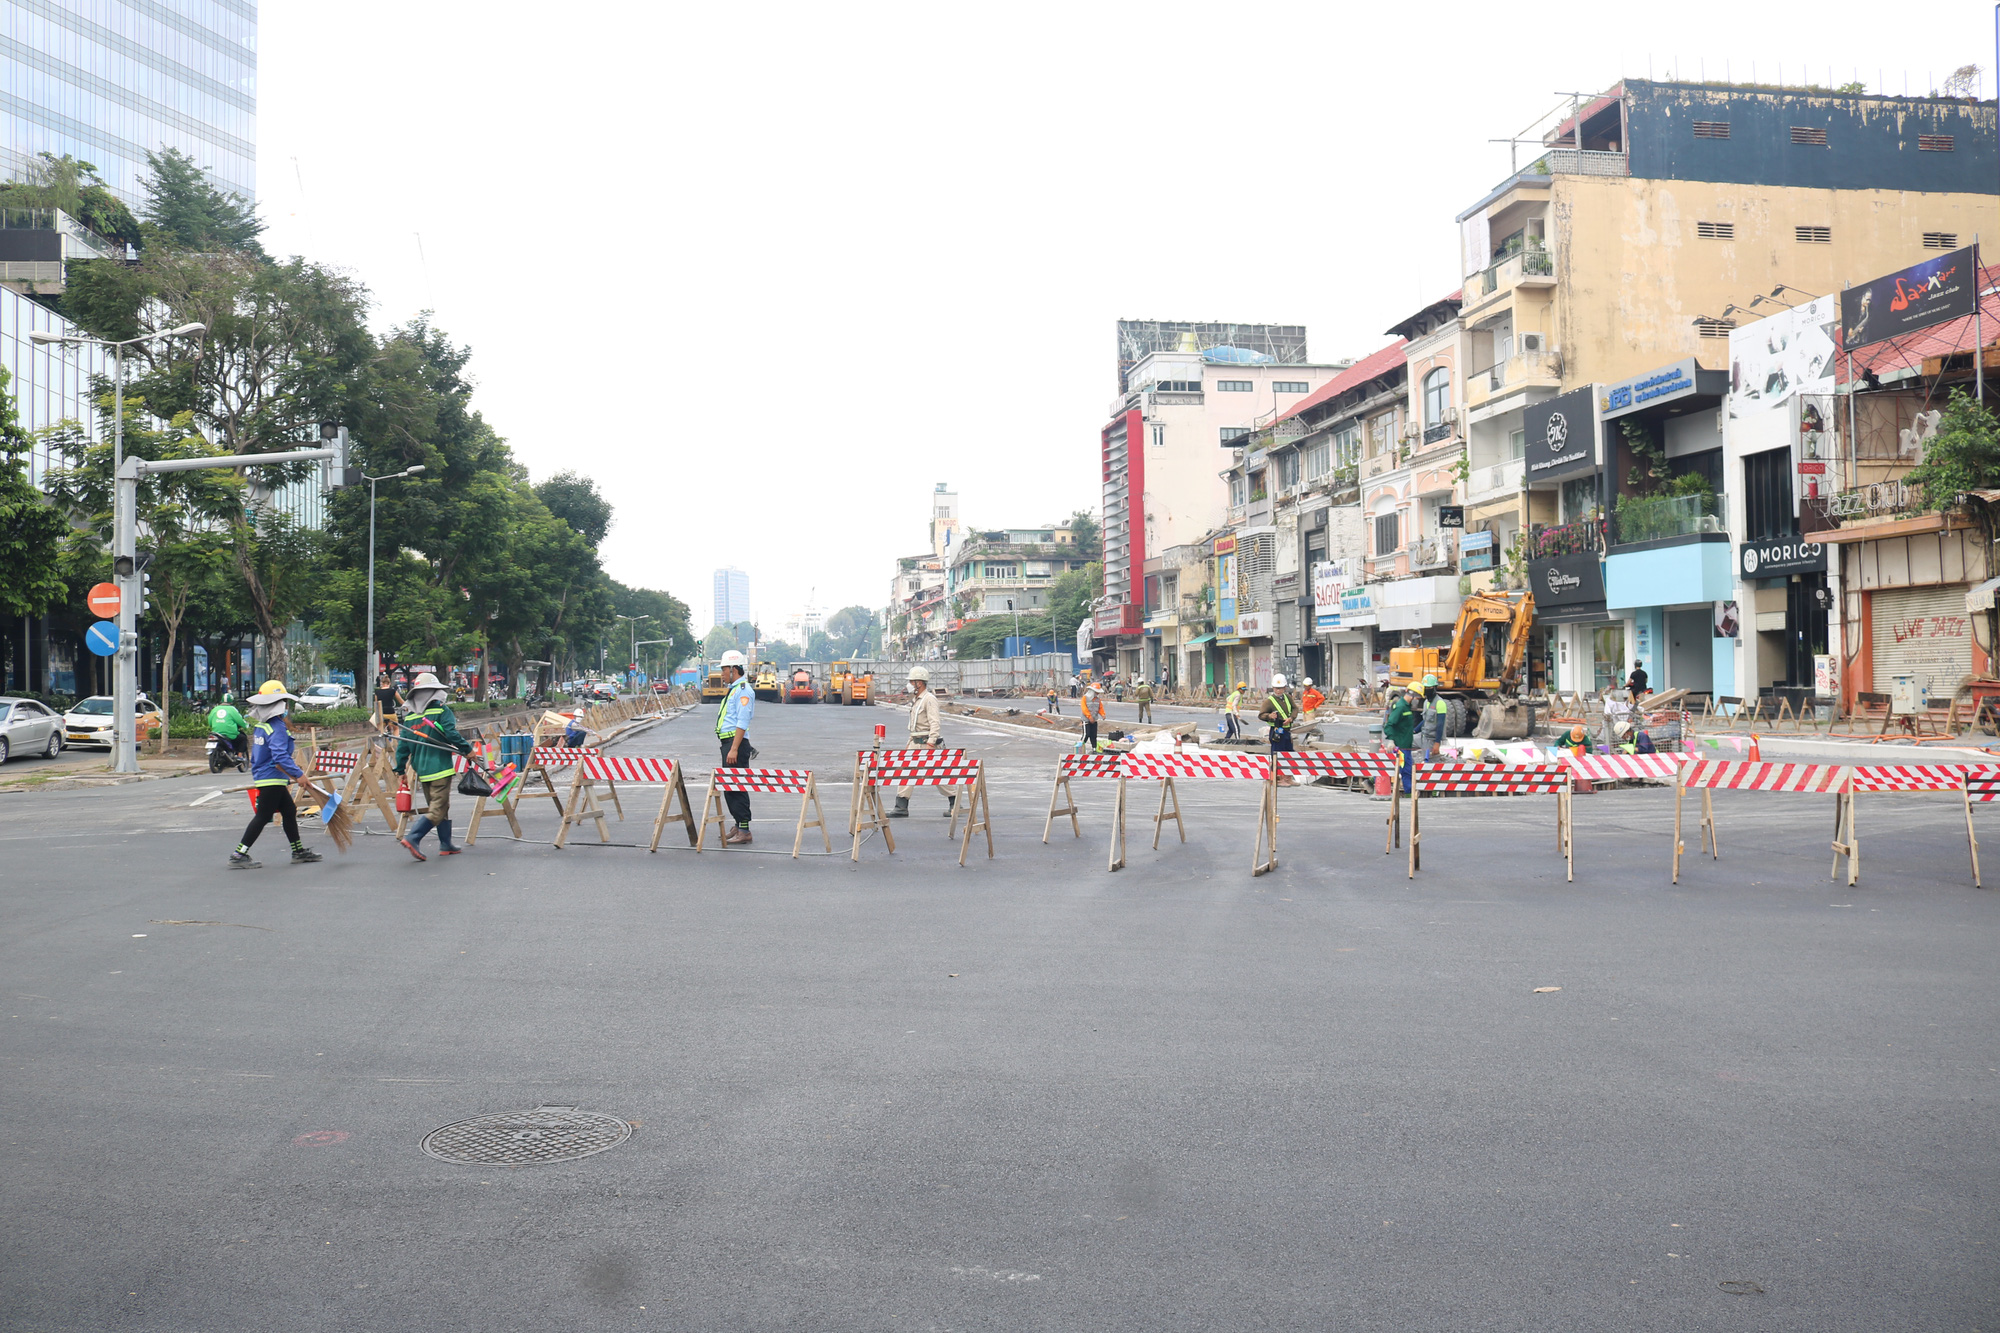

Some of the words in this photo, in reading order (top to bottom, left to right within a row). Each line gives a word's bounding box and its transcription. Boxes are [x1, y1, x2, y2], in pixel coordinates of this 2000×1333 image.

[1801, 313, 1826, 325] MORICO
[1824, 492, 1865, 518] Jazz
[1866, 479, 1909, 509] Club
[1760, 543, 1821, 563] MORICO
[1894, 617, 1924, 643] LIVE
[1930, 617, 1965, 637] JAZZ
